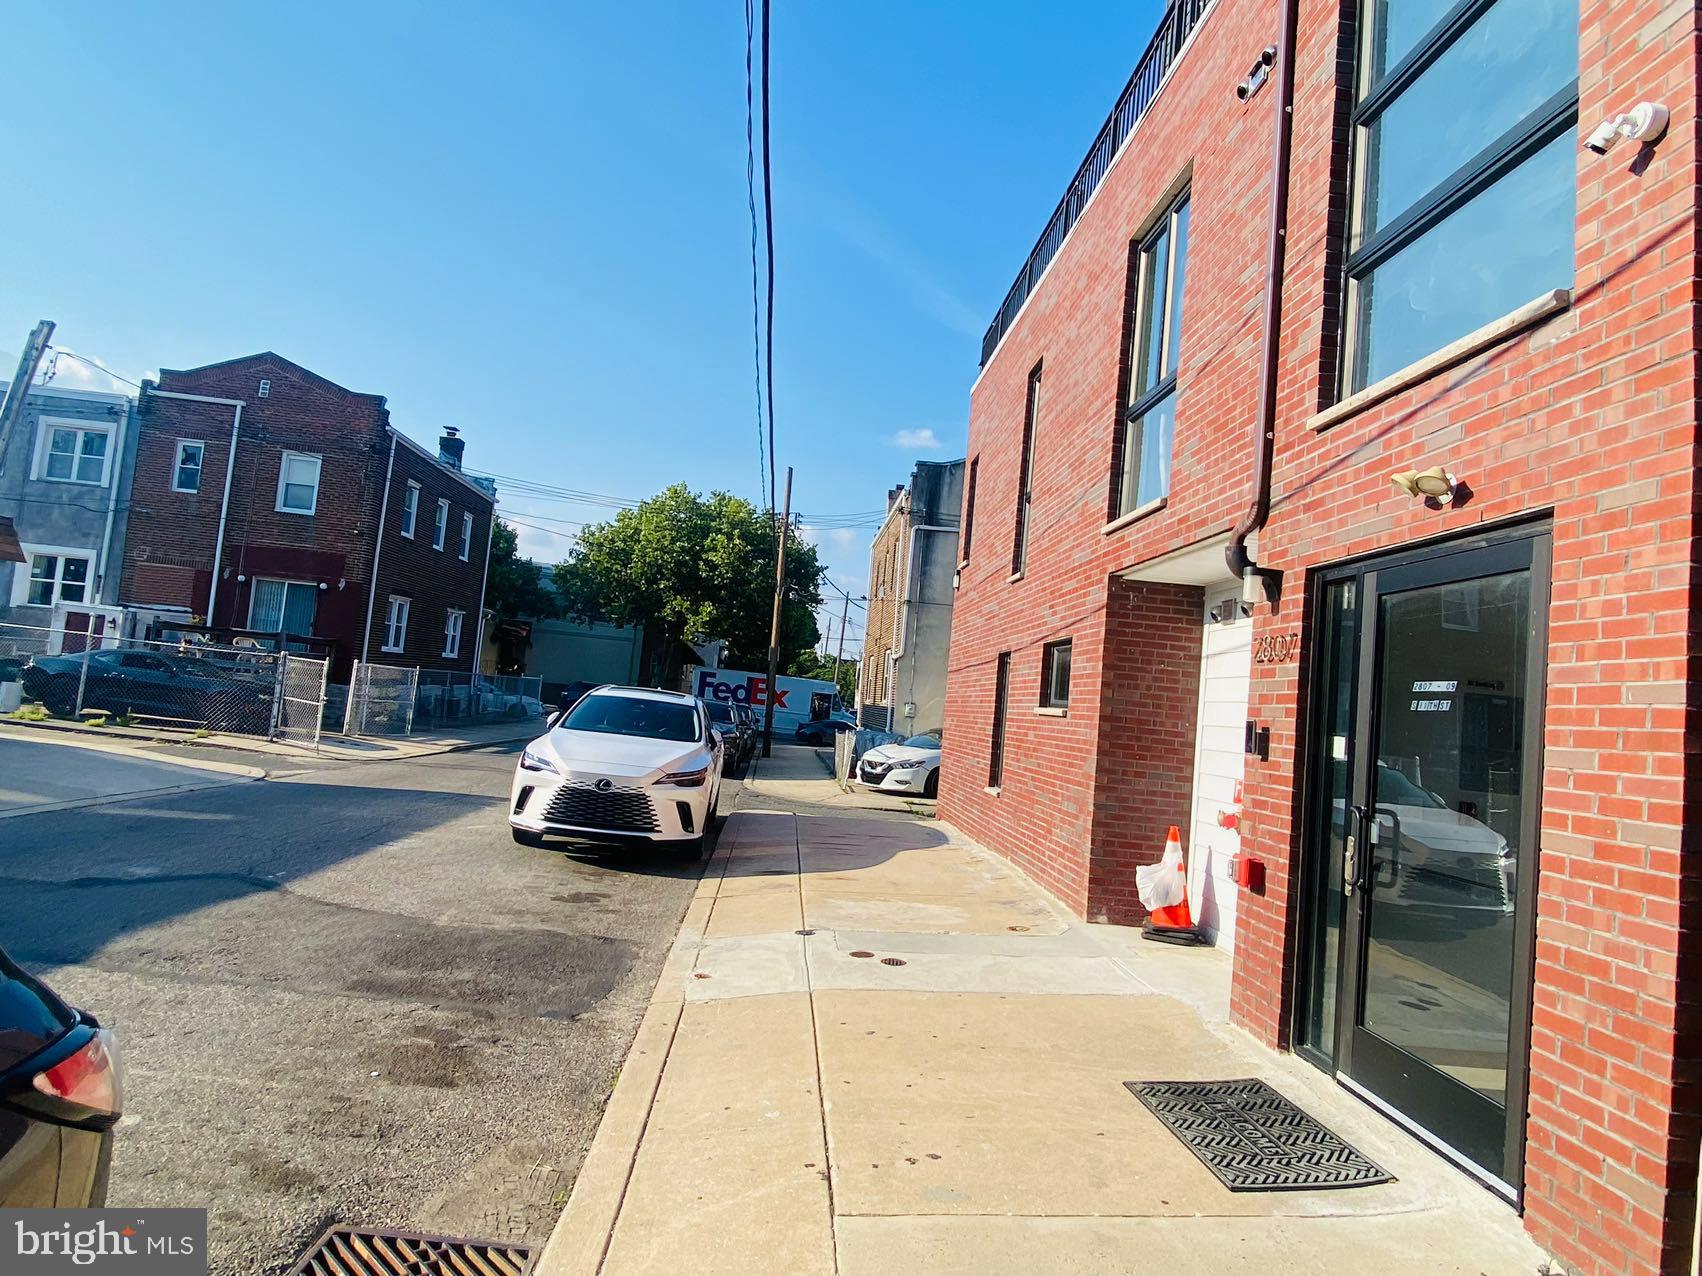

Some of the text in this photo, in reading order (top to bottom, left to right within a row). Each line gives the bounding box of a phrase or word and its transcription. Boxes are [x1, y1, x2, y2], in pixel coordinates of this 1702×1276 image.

[1255, 633, 1298, 663] 2807
[699, 671, 790, 708] FedEx
[1413, 682, 1432, 690] 2807
[1446, 682, 1456, 690] 09
[1440, 701, 1450, 710] ST
